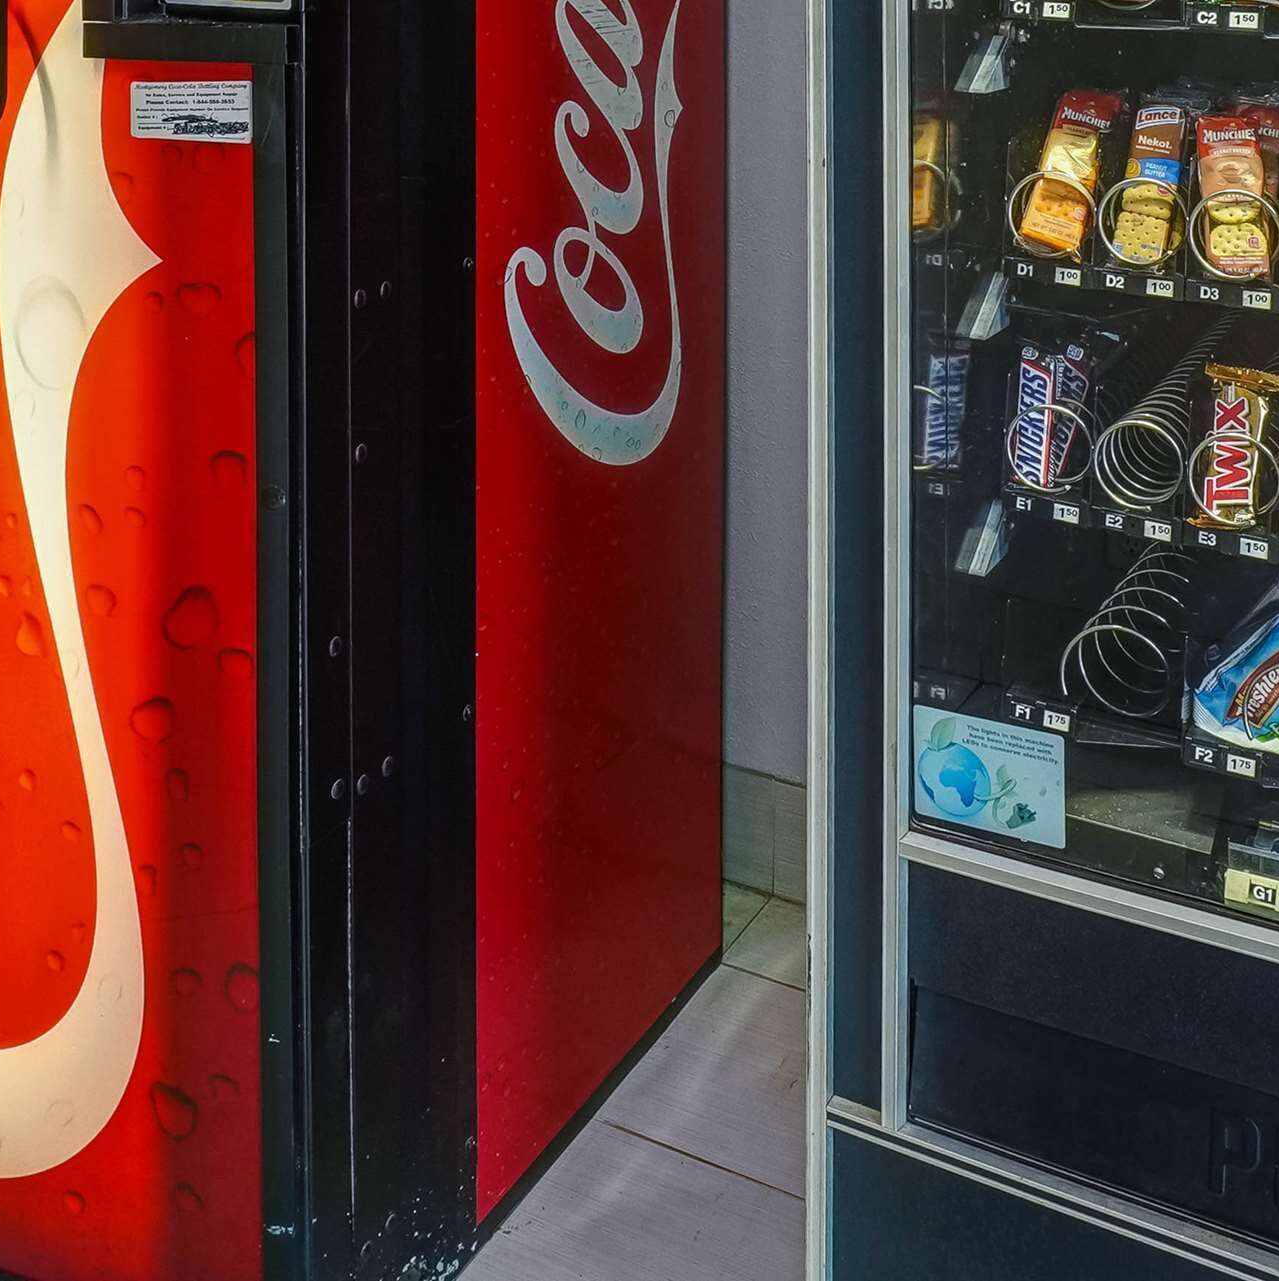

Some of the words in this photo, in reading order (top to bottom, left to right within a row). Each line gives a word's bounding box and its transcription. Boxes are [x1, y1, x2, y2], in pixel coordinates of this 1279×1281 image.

[1013, 2, 1030, 14] C1
[1198, 11, 1217, 24] C2
[1137, 108, 1178, 122] Lance
[1017, 264, 1034, 276] D1
[1106, 276, 1124, 289] D2
[1017, 497, 1032, 511] E1
[1106, 515, 1123, 528] E2
[1015, 705, 1031, 719] F1
[1195, 748, 1213, 763] F2
[1254, 887, 1273, 901] G1
